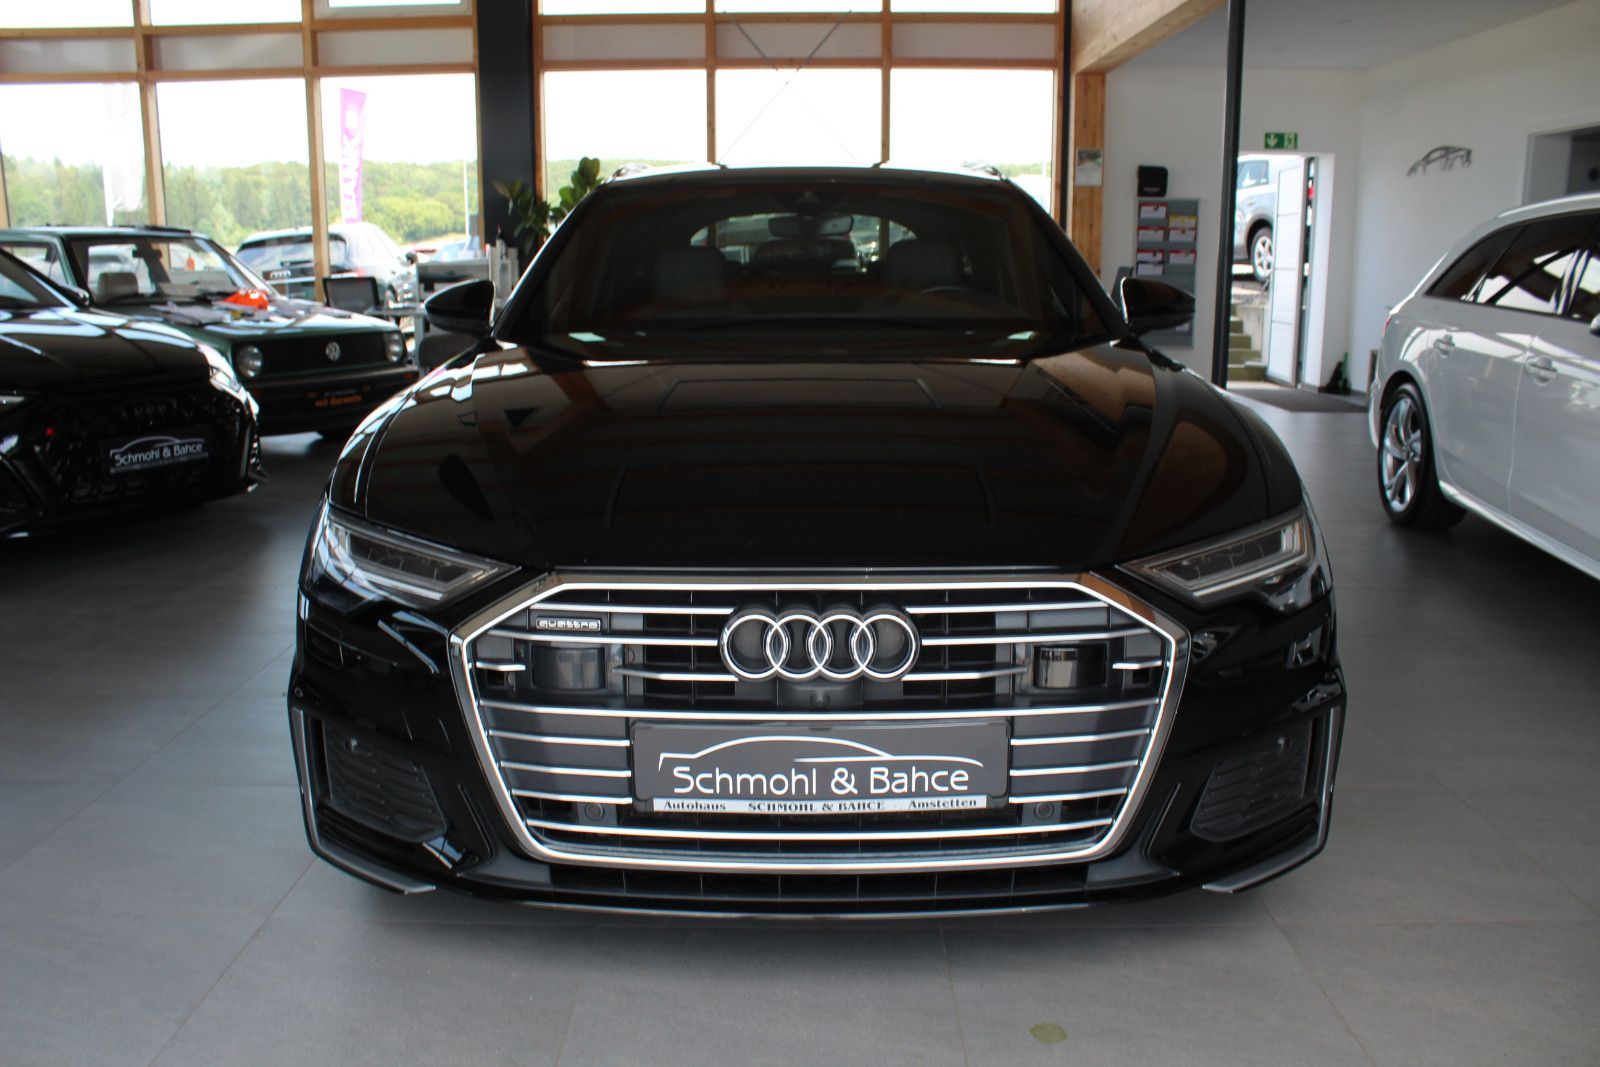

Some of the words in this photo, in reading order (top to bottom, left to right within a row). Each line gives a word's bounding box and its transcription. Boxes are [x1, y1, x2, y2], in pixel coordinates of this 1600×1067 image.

[114, 448, 161, 466] Schmohl
[162, 446, 172, 458] &
[173, 442, 203, 457] Bahce
[539, 618, 599, 629] quattro
[673, 765, 817, 796] Schmohl
[830, 766, 858, 796] &
[870, 765, 969, 795] Bahce
[663, 800, 727, 811] Autohaus
[748, 802, 817, 813] SCHMOHL
[821, 802, 834, 812] &
[838, 801, 886, 812] BAHCE
[908, 798, 977, 810] Amstetten
